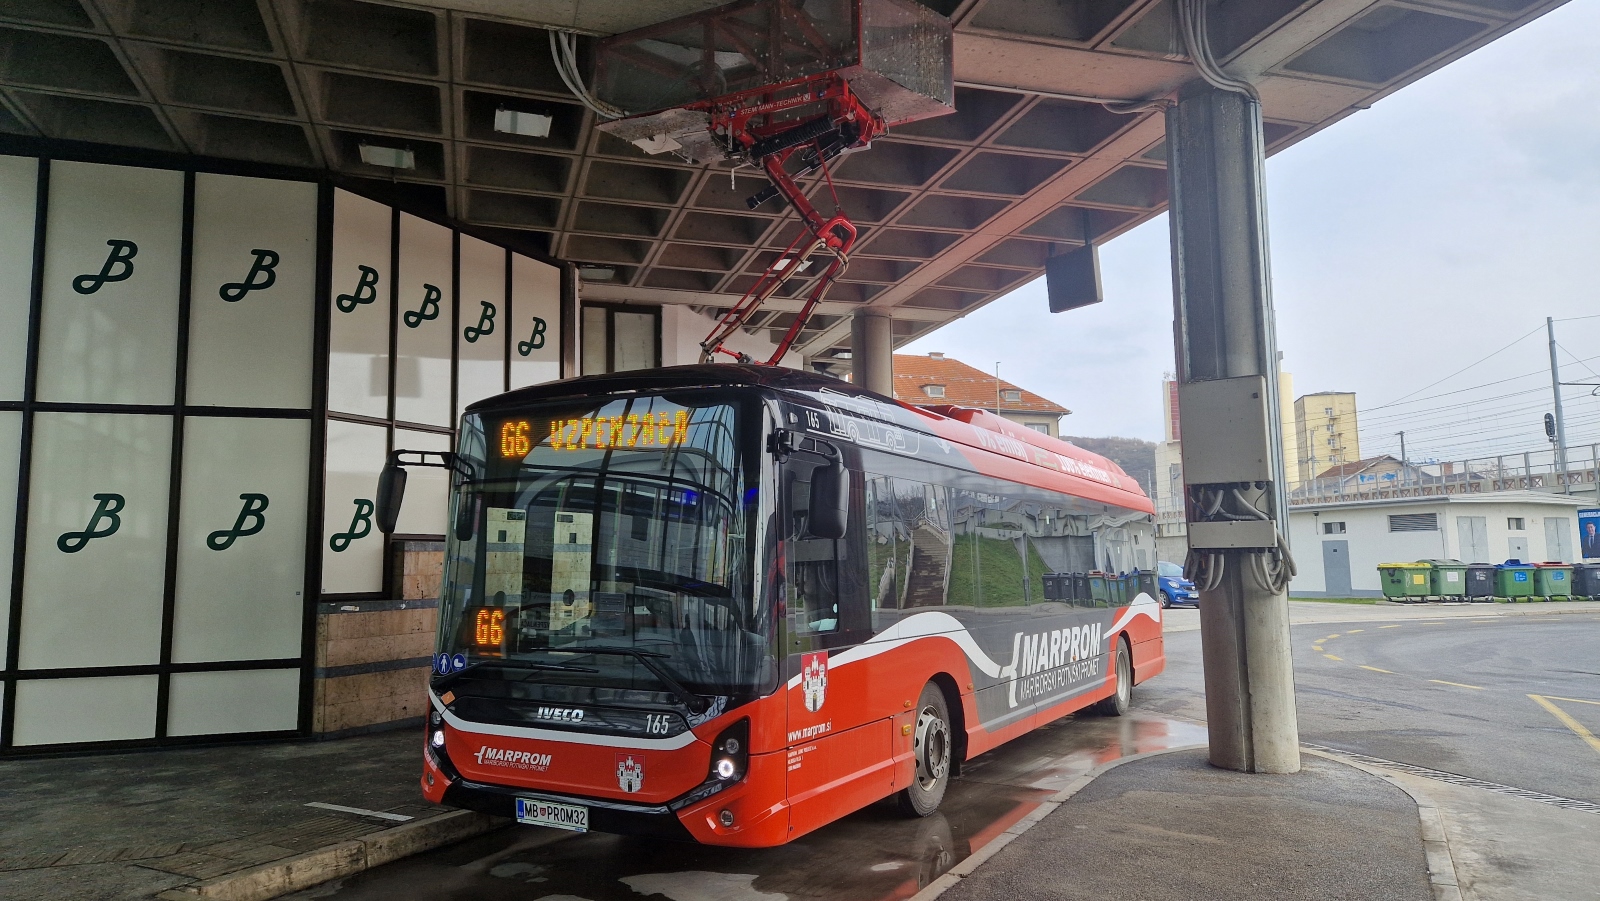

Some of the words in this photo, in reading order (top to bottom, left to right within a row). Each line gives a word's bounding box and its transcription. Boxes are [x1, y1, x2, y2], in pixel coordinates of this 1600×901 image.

[73, 239, 138, 295] B
[219, 249, 280, 302] B
[336, 265, 379, 313] B
[404, 283, 441, 328] B
[464, 301, 496, 343] B
[518, 317, 546, 356] B
[550, 410, 687, 451] VZPENJAČA
[805, 410, 820, 429] 165
[57, 494, 125, 553] B
[207, 493, 269, 551] B
[330, 499, 374, 552] B
[1021, 623, 1101, 677] MARPROM
[1020, 671, 1056, 701] MARIBORSKI
[1080, 658, 1099, 680] PROMET
[536, 706, 584, 723] IVECO
[645, 714, 669, 735] 165
[787, 721, 832, 742] www.marprom.si
[485, 747, 552, 766] MARPROM
[524, 802, 539, 818] MB
[547, 805, 586, 825] PROM32
